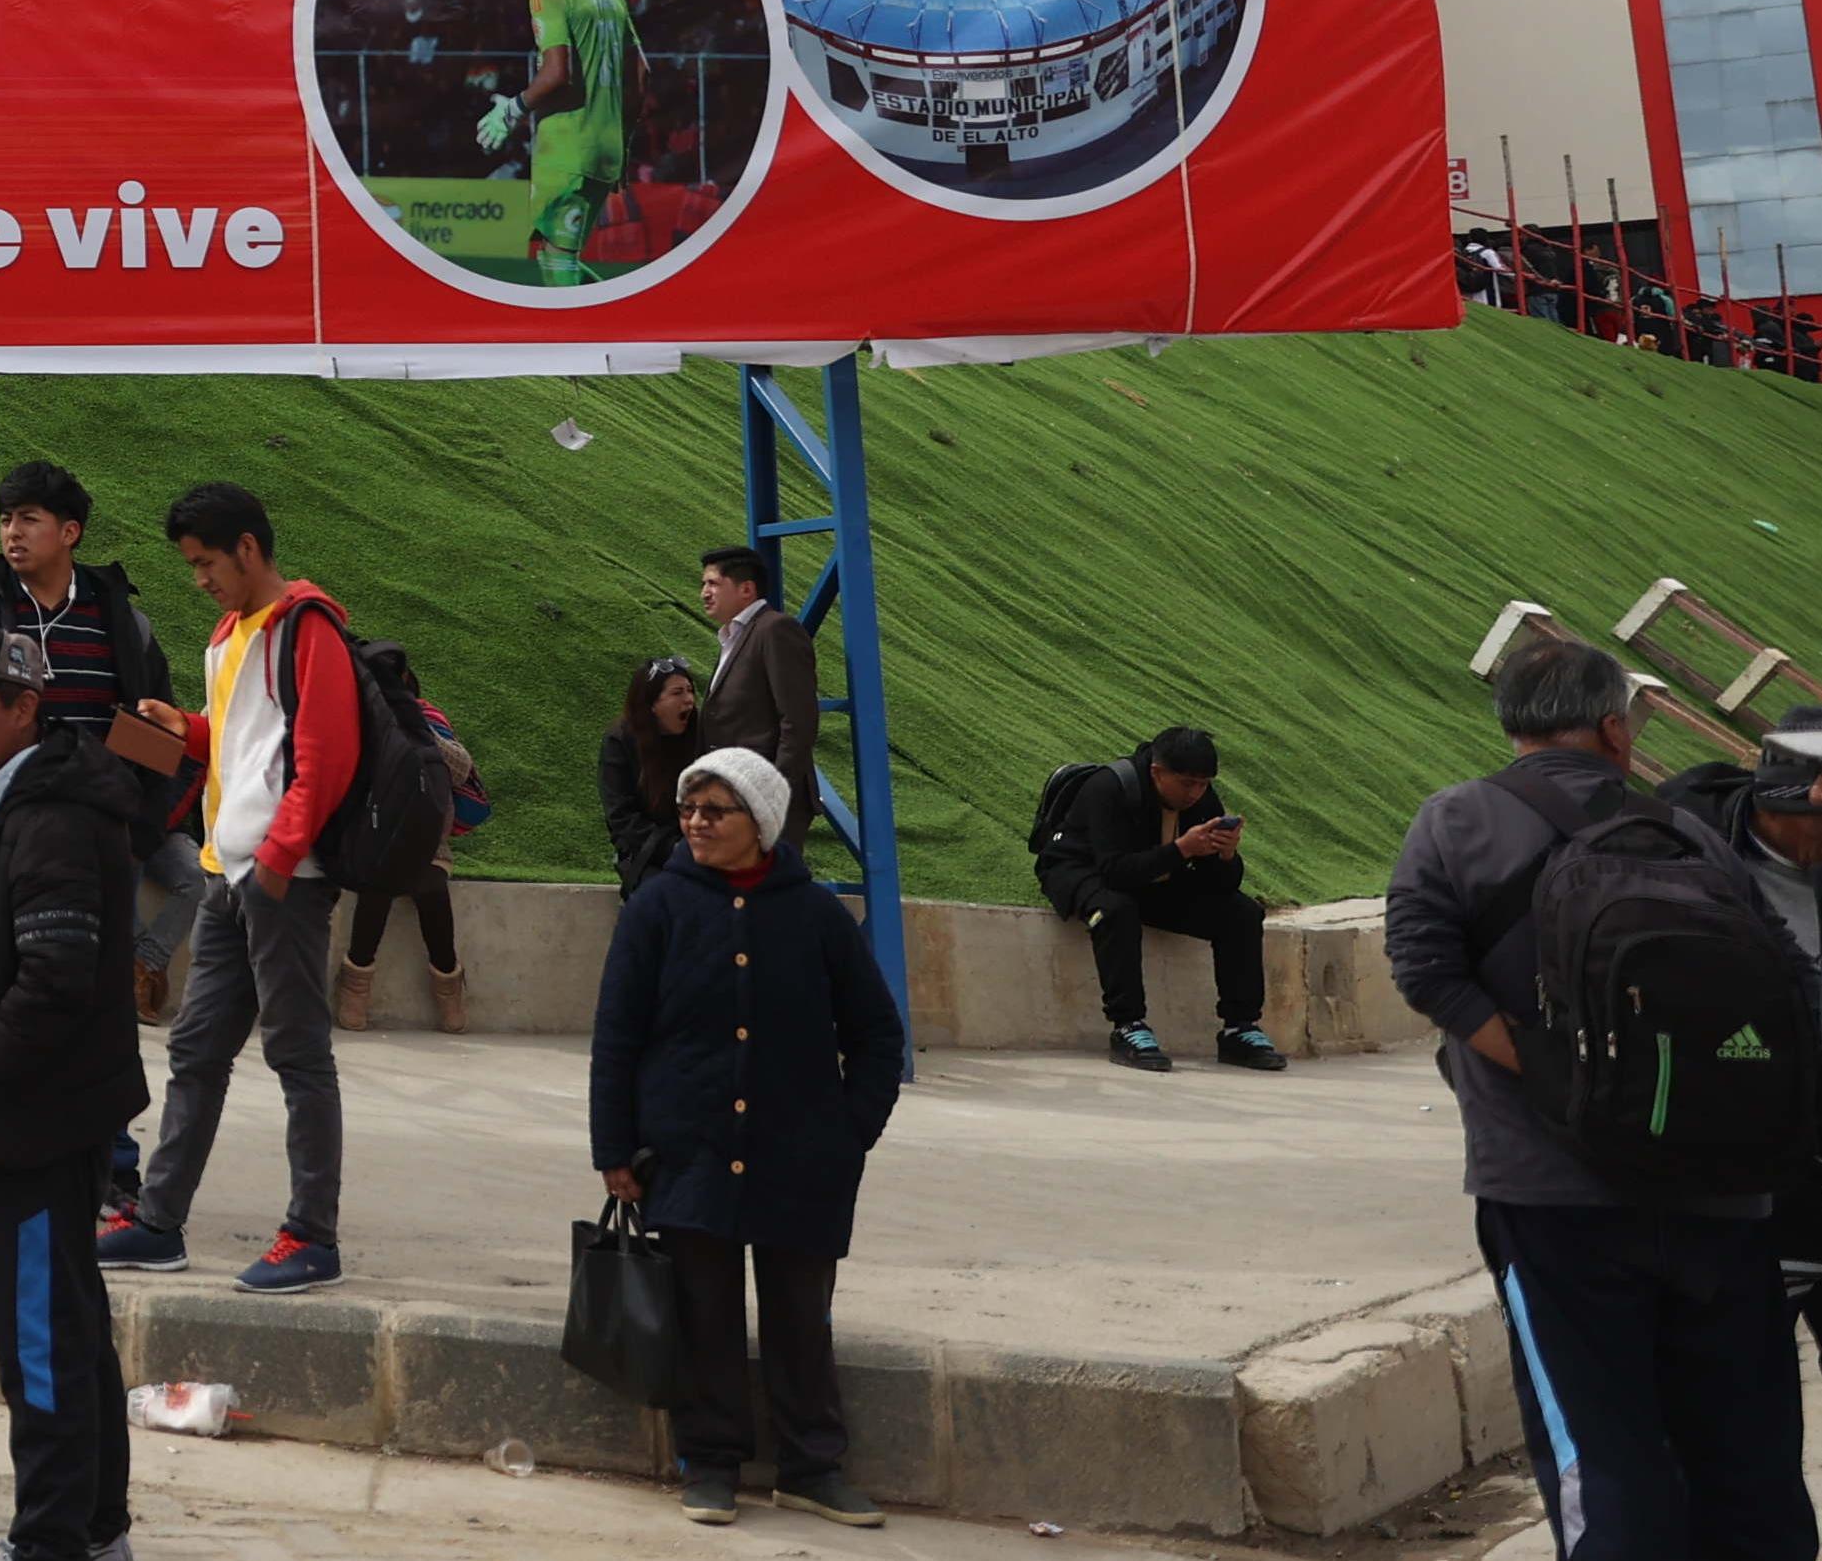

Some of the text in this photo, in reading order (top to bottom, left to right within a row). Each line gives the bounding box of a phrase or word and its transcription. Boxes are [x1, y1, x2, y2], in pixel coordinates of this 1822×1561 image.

[932, 68, 1013, 81] Bienvenidos
[871, 88, 1091, 117] ESTADIO MUNICIPAL
[933, 125, 1038, 143] DE EL ALTO
[410, 200, 505, 222] mercado
[46, 180, 285, 271] vive
[1716, 1046, 1771, 1059] adidas
